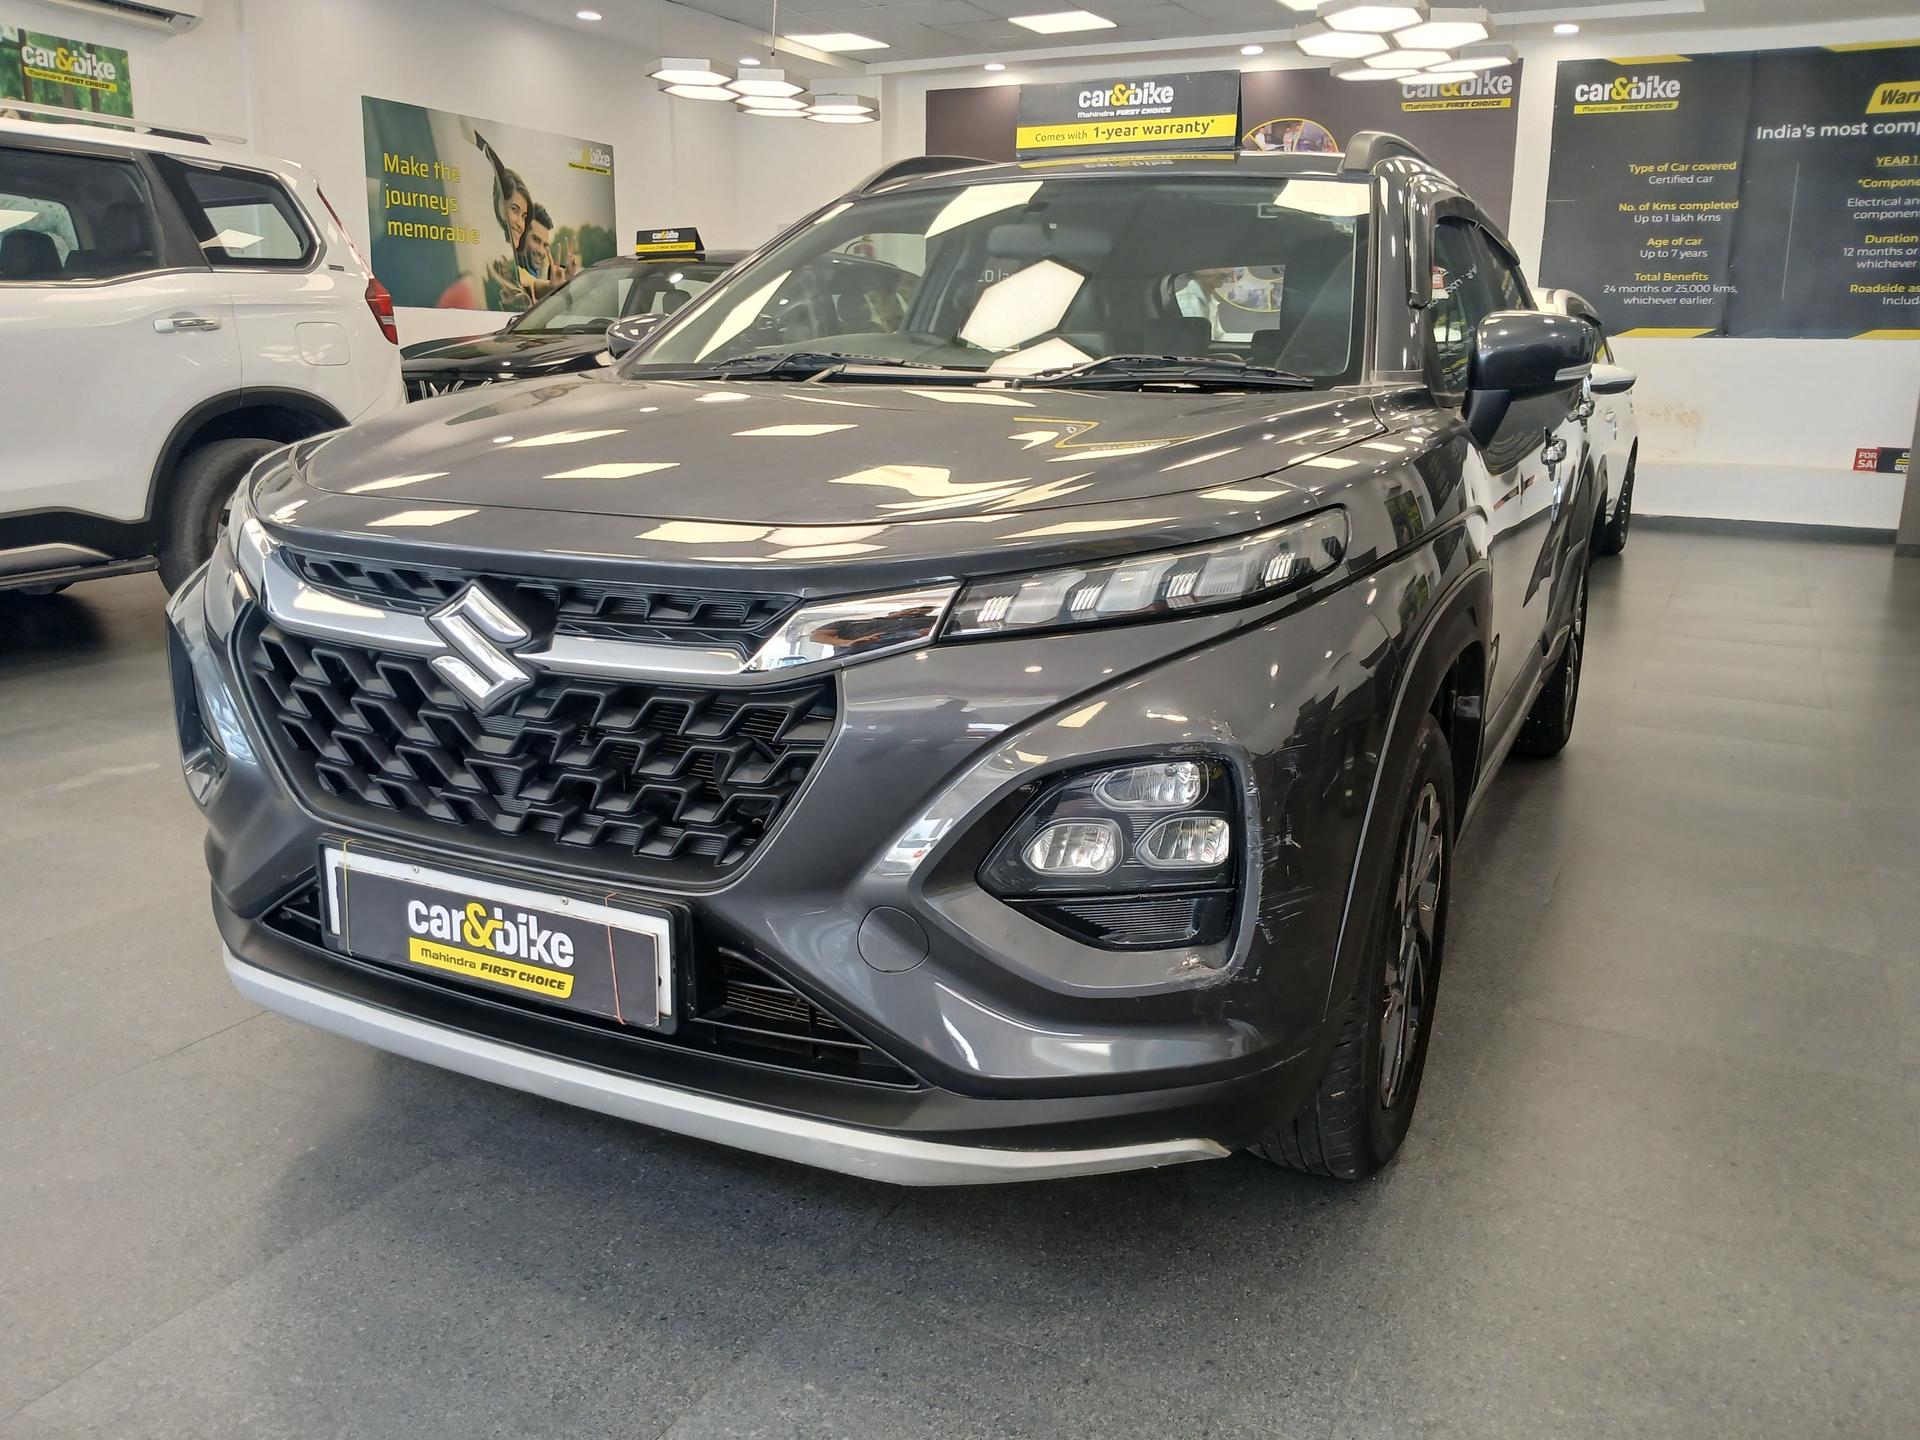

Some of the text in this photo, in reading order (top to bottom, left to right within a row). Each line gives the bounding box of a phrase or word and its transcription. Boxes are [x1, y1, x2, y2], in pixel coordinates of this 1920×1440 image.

[21, 45, 116, 80] car&bike
[64, 76, 85, 84] FIRST
[85, 80, 110, 89] CHOICE
[1575, 75, 1681, 102] car&bike
[1078, 81, 1175, 108] car&bike
[1405, 102, 1443, 110] Mahindra
[1077, 106, 1172, 119] Mahindra FIRST CHOICE
[1035, 132, 1065, 142] Comes
[1067, 130, 1088, 140] with
[1093, 126, 1138, 141] 1-year
[1756, 124, 1815, 140] India's
[1820, 122, 1868, 137] most
[1876, 155, 1918, 165] YEAR 1
[383, 152, 461, 182] Make the
[1628, 161, 1737, 175] Type of Car covered
[1648, 174, 1714, 185] Certified car
[385, 183, 458, 215] journeys
[1847, 197, 1920, 207] Electrical an
[1618, 200, 1739, 212] No. of Kms completed
[1633, 214, 1649, 224] Up
[1652, 214, 1663, 223] to
[1671, 213, 1694, 222] lakh
[1697, 213, 1721, 222] Kms
[387, 220, 480, 244] memorable
[1646, 237, 1703, 248] Age of car
[1865, 233, 1919, 244] Duration
[1640, 249, 1708, 259] Up to 7 years
[1843, 247, 1919, 257] 12 months or
[1856, 259, 1918, 269] whichever
[1634, 271, 1709, 281] Total Benefits
[1603, 284, 1738, 294] 24 months or 25,000 kms,
[1849, 283, 1905, 293] Roadside
[1623, 296, 1714, 305] whichever earlier.
[1882, 296, 1920, 305] Includ
[407, 899, 575, 968] car&bike
[421, 947, 566, 991] Mahindra FIRST CHOICE
